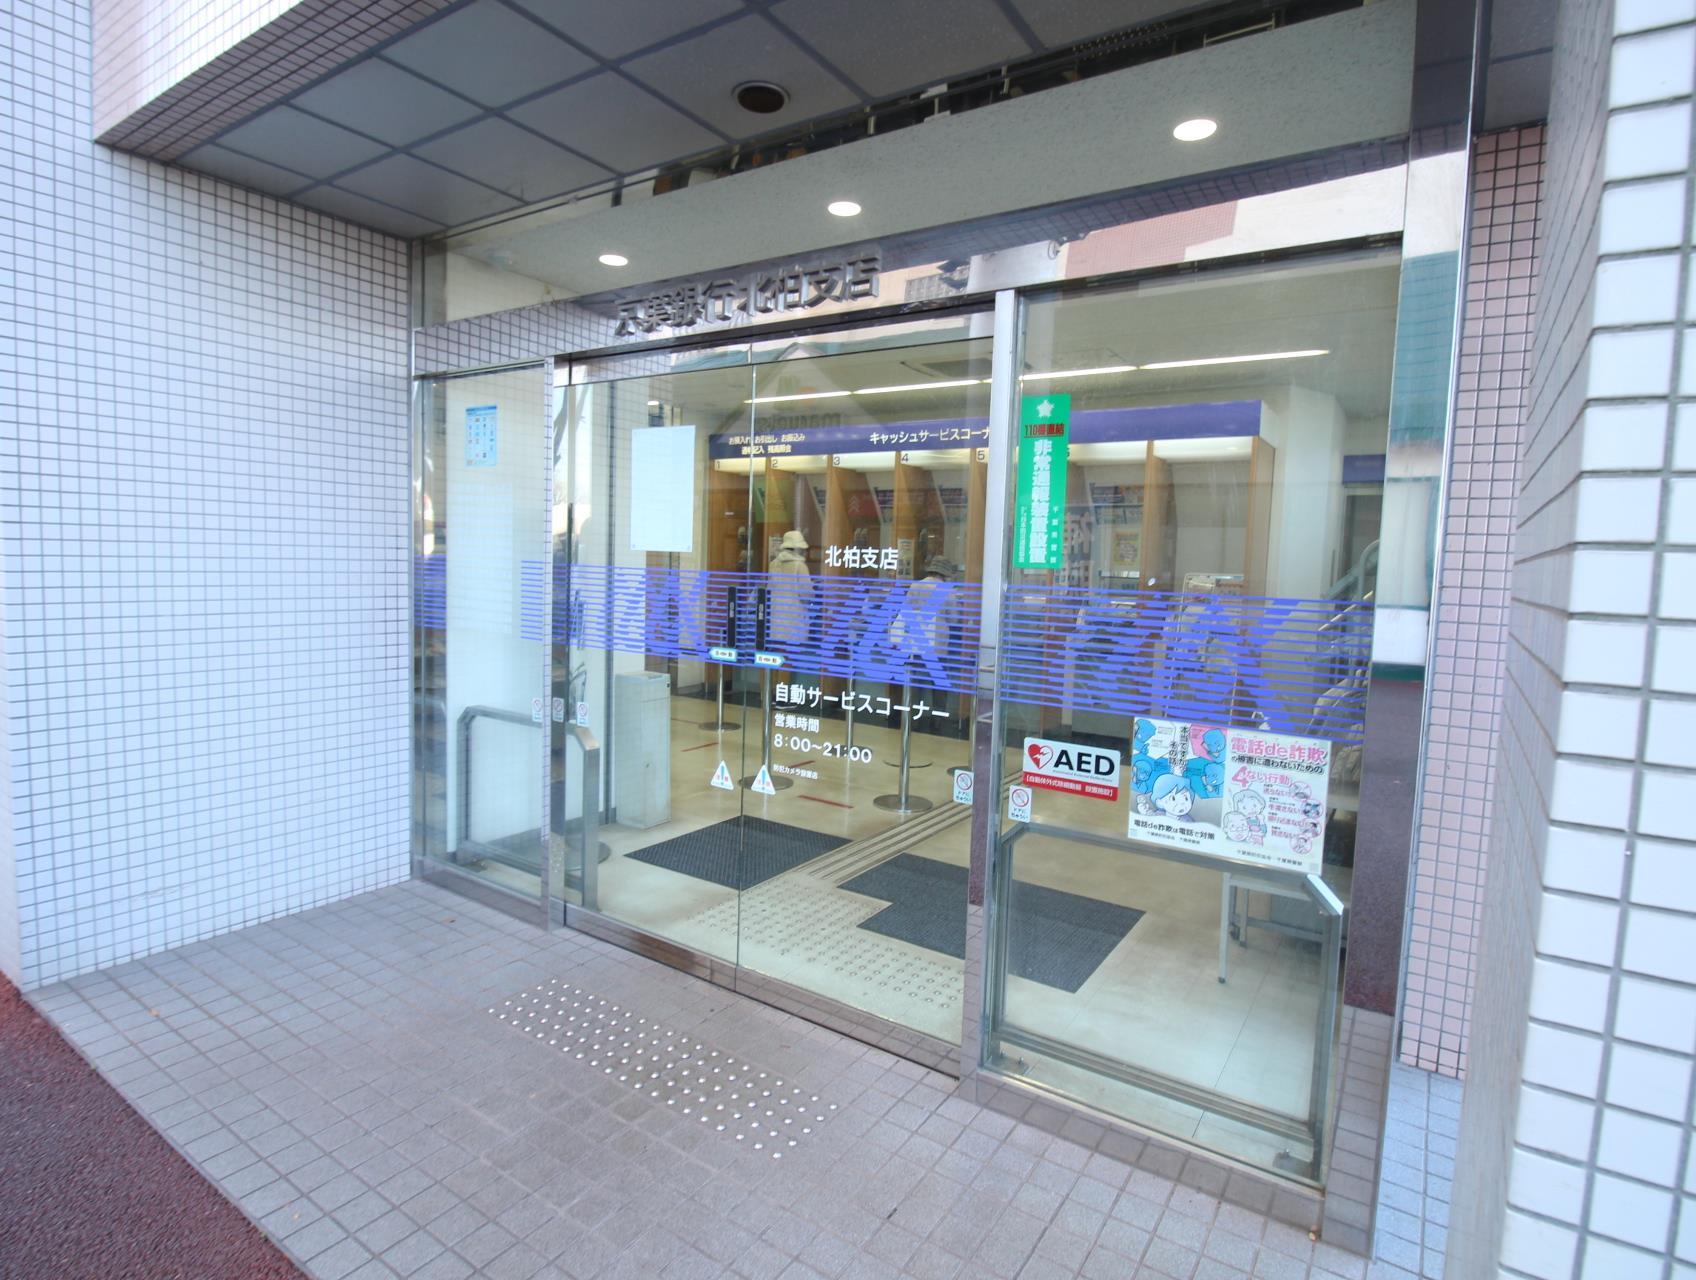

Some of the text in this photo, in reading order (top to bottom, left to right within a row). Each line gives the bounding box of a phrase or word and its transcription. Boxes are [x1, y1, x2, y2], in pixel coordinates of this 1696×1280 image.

[869, 425, 991, 445] キャッシュサービスコーナ
[771, 459, 779, 468] 2
[832, 456, 841, 466] 3
[901, 453, 909, 463] 4
[977, 450, 985, 461] 5
[825, 545, 899, 571] 北柏支店
[775, 682, 951, 721] 自動サービスコーナー
[774, 713, 820, 734] 営業時間
[1231, 735, 1328, 766] 電話de詐欺
[1053, 748, 1115, 777] AED
